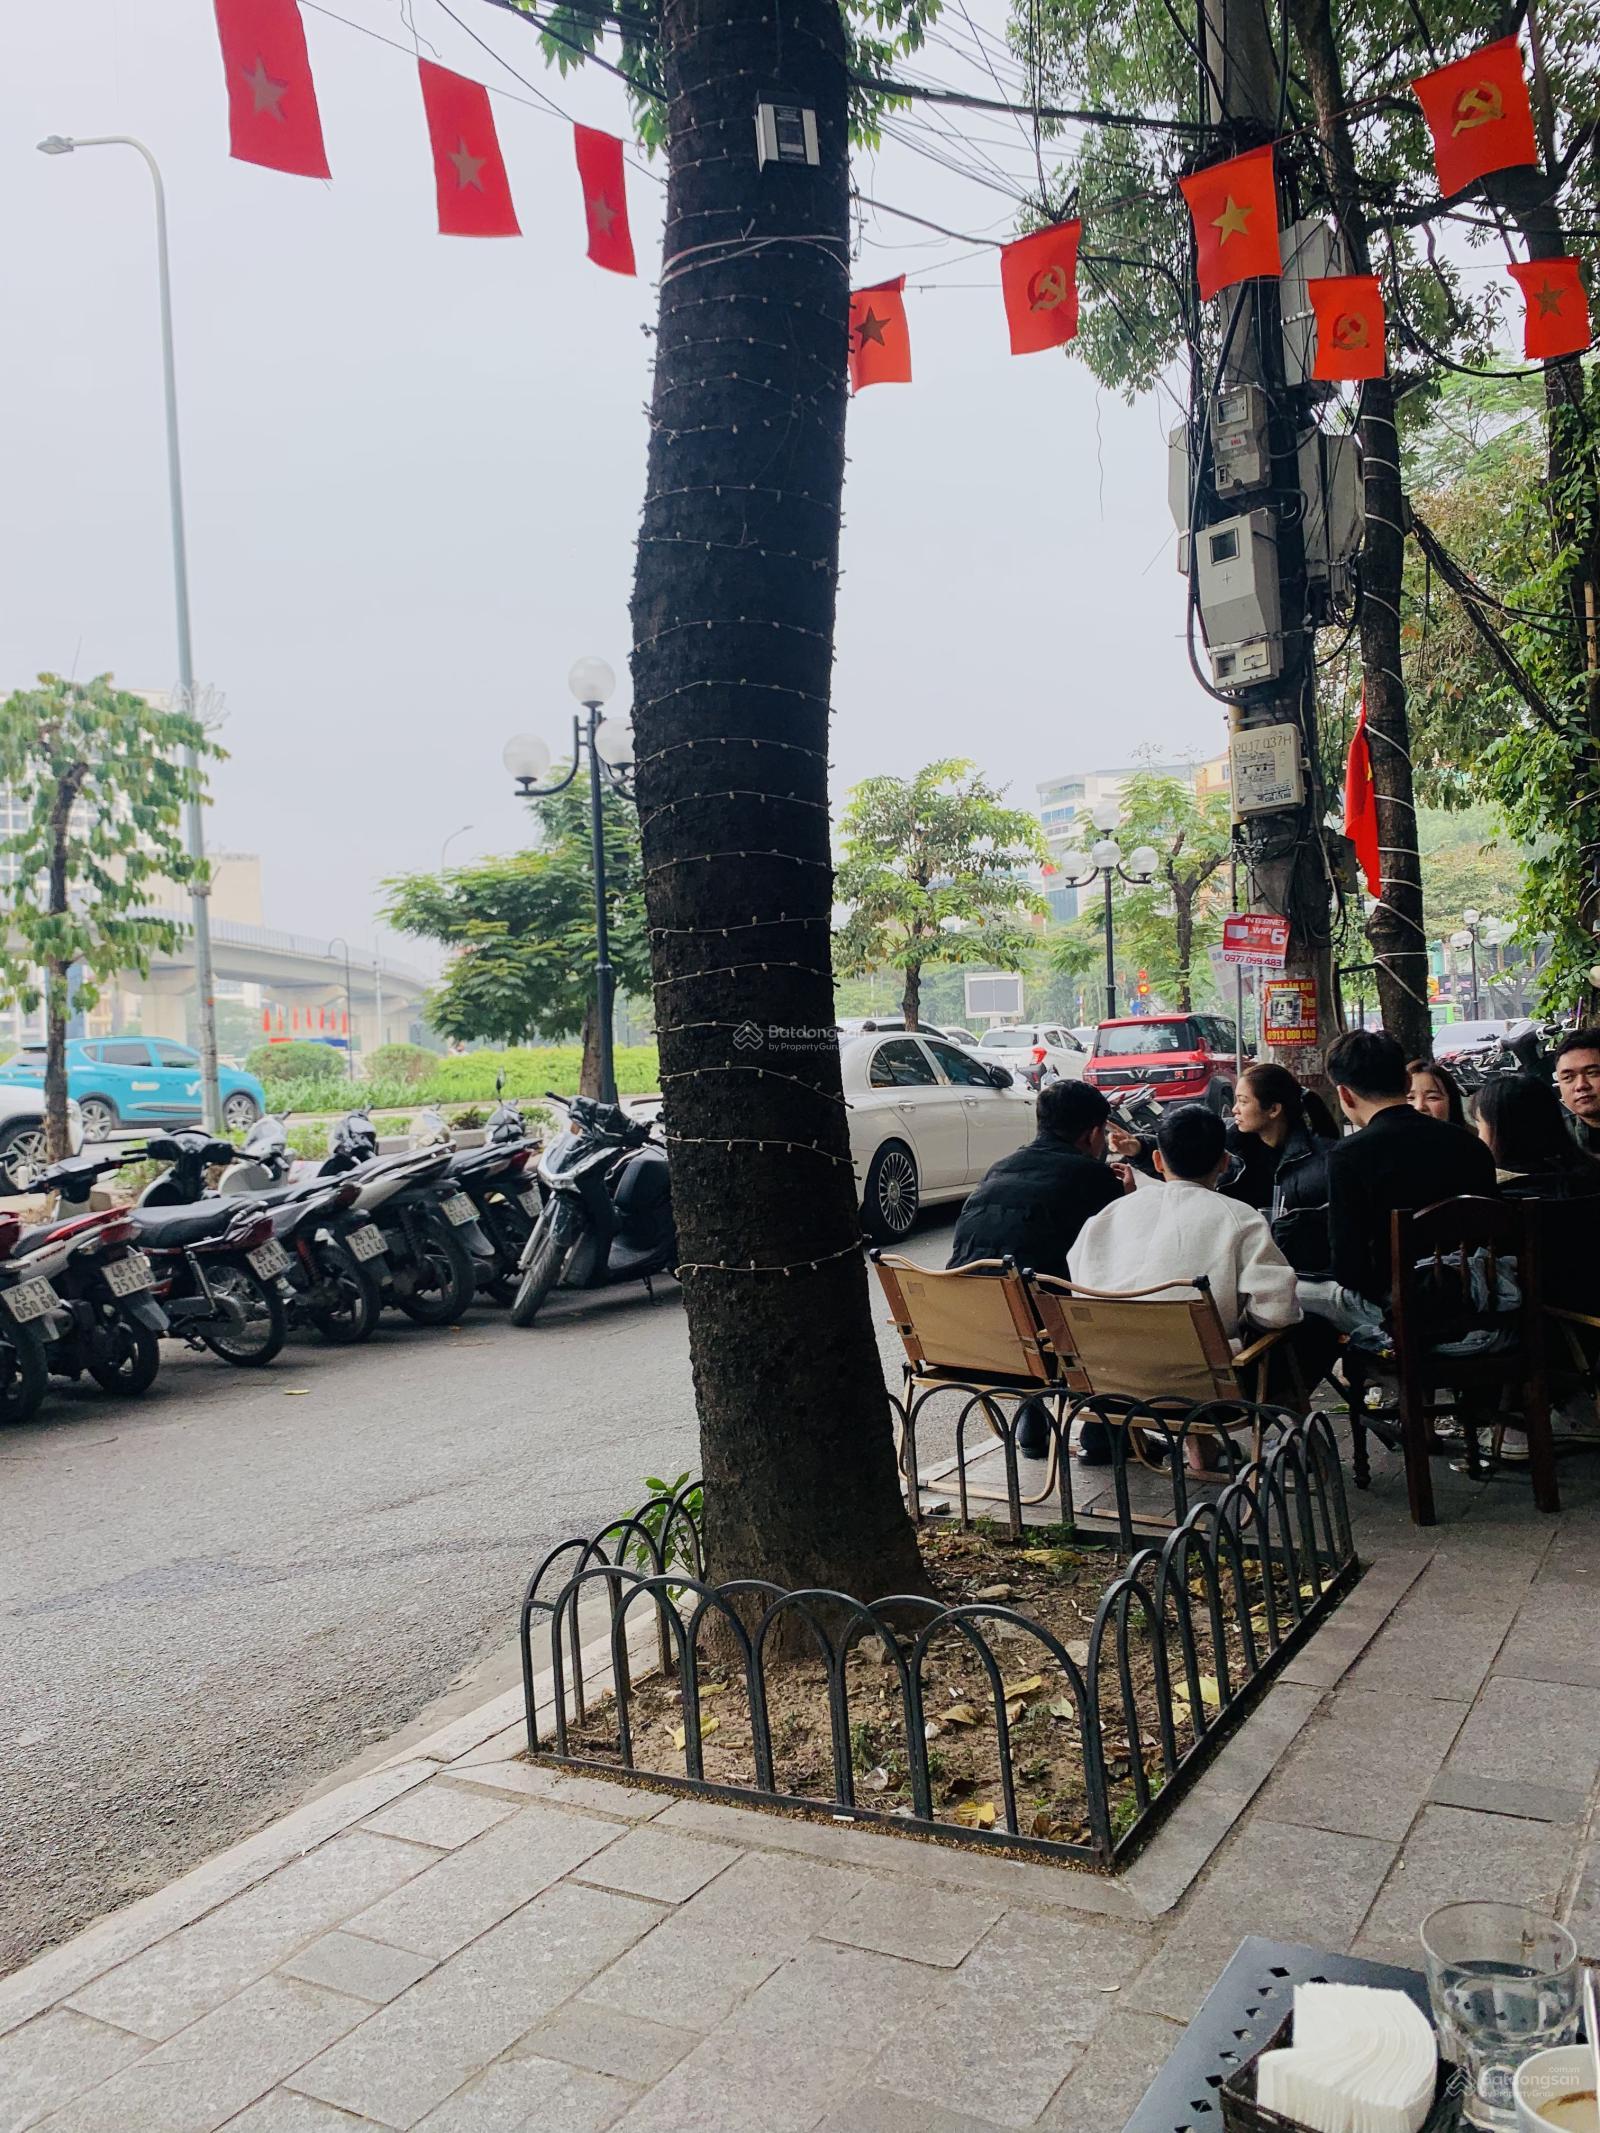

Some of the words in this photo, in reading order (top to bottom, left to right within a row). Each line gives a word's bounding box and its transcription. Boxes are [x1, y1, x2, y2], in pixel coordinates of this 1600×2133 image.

[1245, 917, 1286, 927] INTERNET
[1252, 926, 1271, 936] WIFI
[1271, 928, 1286, 945] 6
